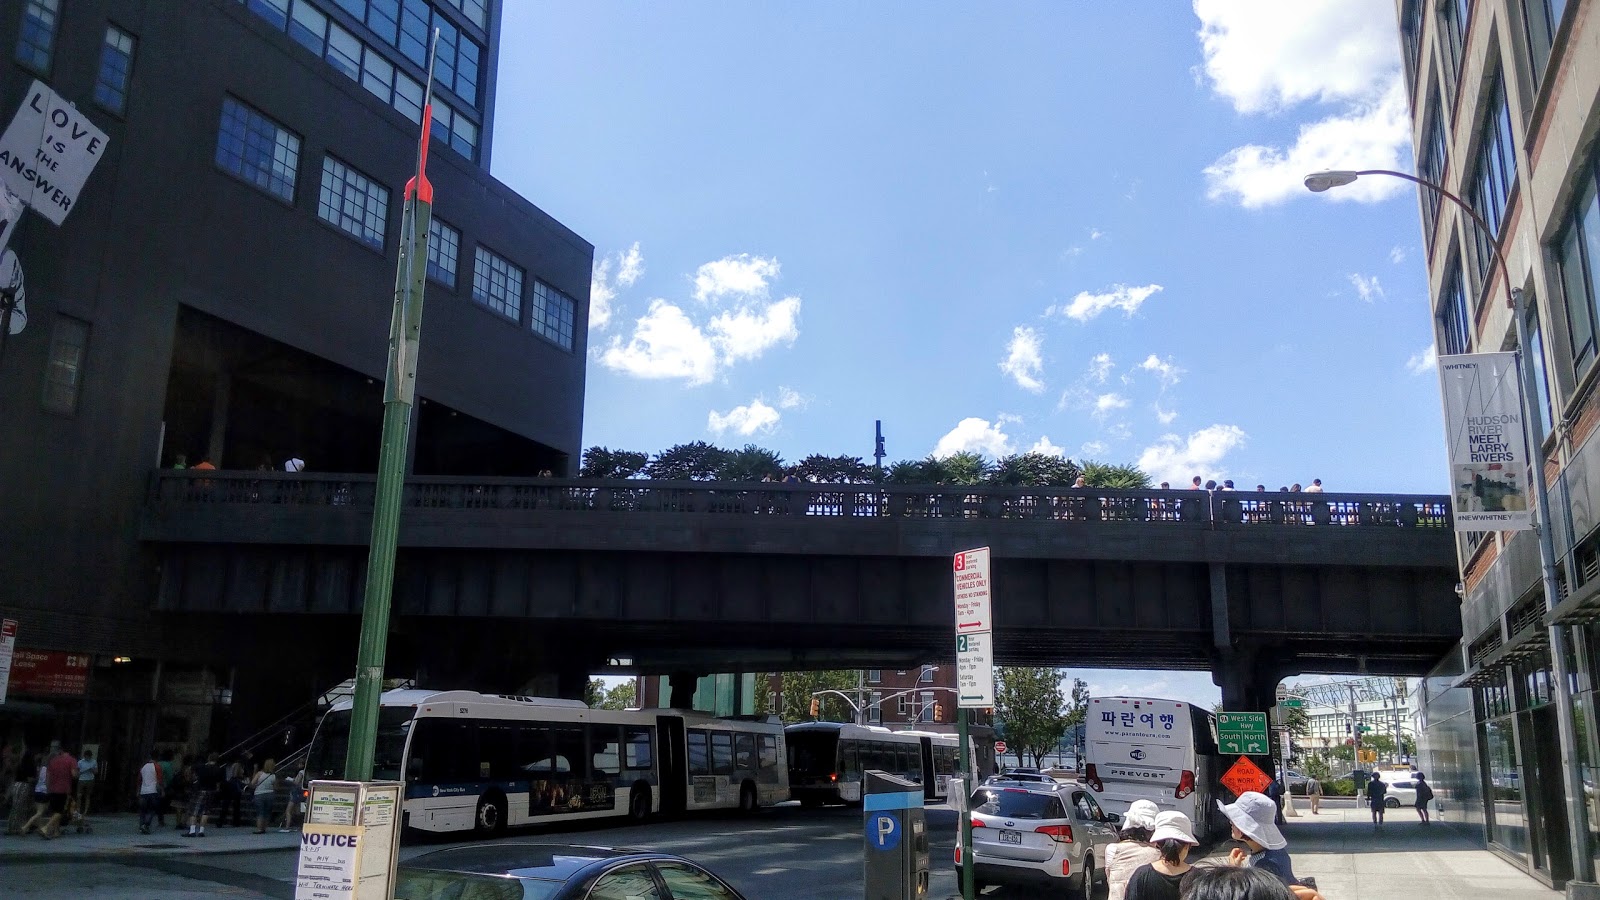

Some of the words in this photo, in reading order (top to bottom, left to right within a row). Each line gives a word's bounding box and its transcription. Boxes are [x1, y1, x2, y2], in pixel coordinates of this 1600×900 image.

[30, 92, 101, 155] LOVE
[46, 134, 66, 154] IS
[36, 148, 60, 172] THE
[0, 150, 71, 212] ANSWER
[1467, 414, 1518, 426] HUDSON
[1468, 425, 1503, 434] RIVER
[1469, 434, 1502, 444] MEET
[1470, 443, 1509, 453] LARRY
[1471, 453, 1514, 462] RIVERS
[957, 556, 963, 570] 3
[957, 572, 982, 582] COMMERCIAL
[957, 581, 975, 590] VEHICLES
[959, 636, 965, 651] 2
[26, 652, 48, 660] Space
[1101, 711, 1174, 730] 파란여행
[1105, 730, 1171, 739] www.parantours.com
[1111, 770, 1166, 779] PREVOST
[878, 817, 894, 845] P
[302, 833, 357, 847] NOTICE
